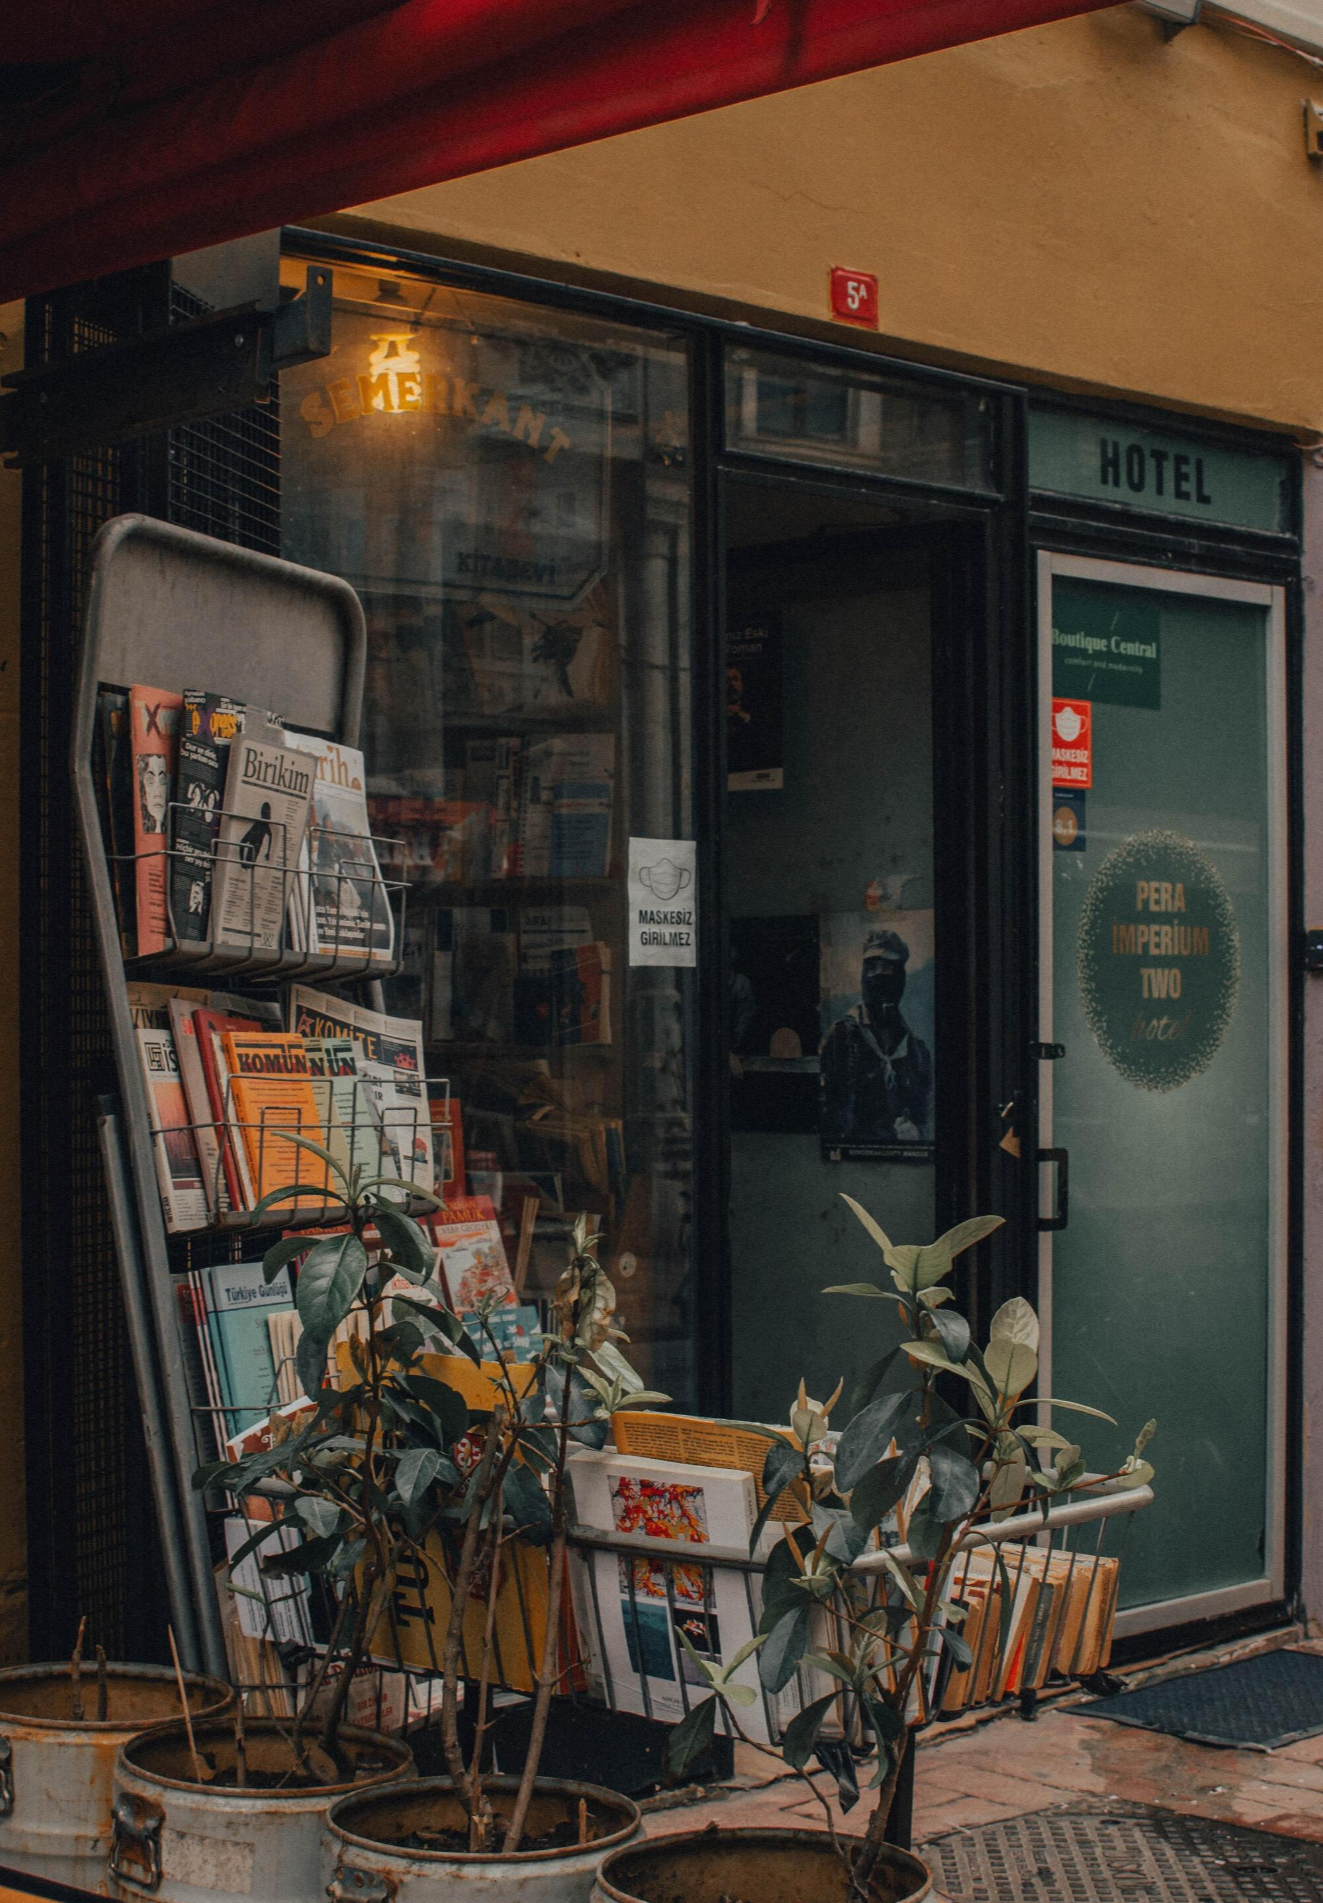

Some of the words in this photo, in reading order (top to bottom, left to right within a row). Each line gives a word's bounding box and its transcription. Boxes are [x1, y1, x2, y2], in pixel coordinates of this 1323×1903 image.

[301, 372, 571, 464] SEMERKANT
[1100, 438, 1213, 504] HOTEL
[1052, 628, 1108, 654] Boutique
[1110, 635, 1157, 659] Central
[242, 747, 310, 794] Birikim
[316, 744, 351, 788] rih
[1136, 881, 1187, 913] PERA
[638, 907, 693, 926] MASKESİZ
[640, 928, 692, 947] GİRİLMEZ
[1139, 967, 1183, 1000] TWO
[442, 1208, 487, 1224] PAMUK
[225, 1286, 258, 1302] Türkiye
[259, 1281, 288, 1298] Günlüğü
